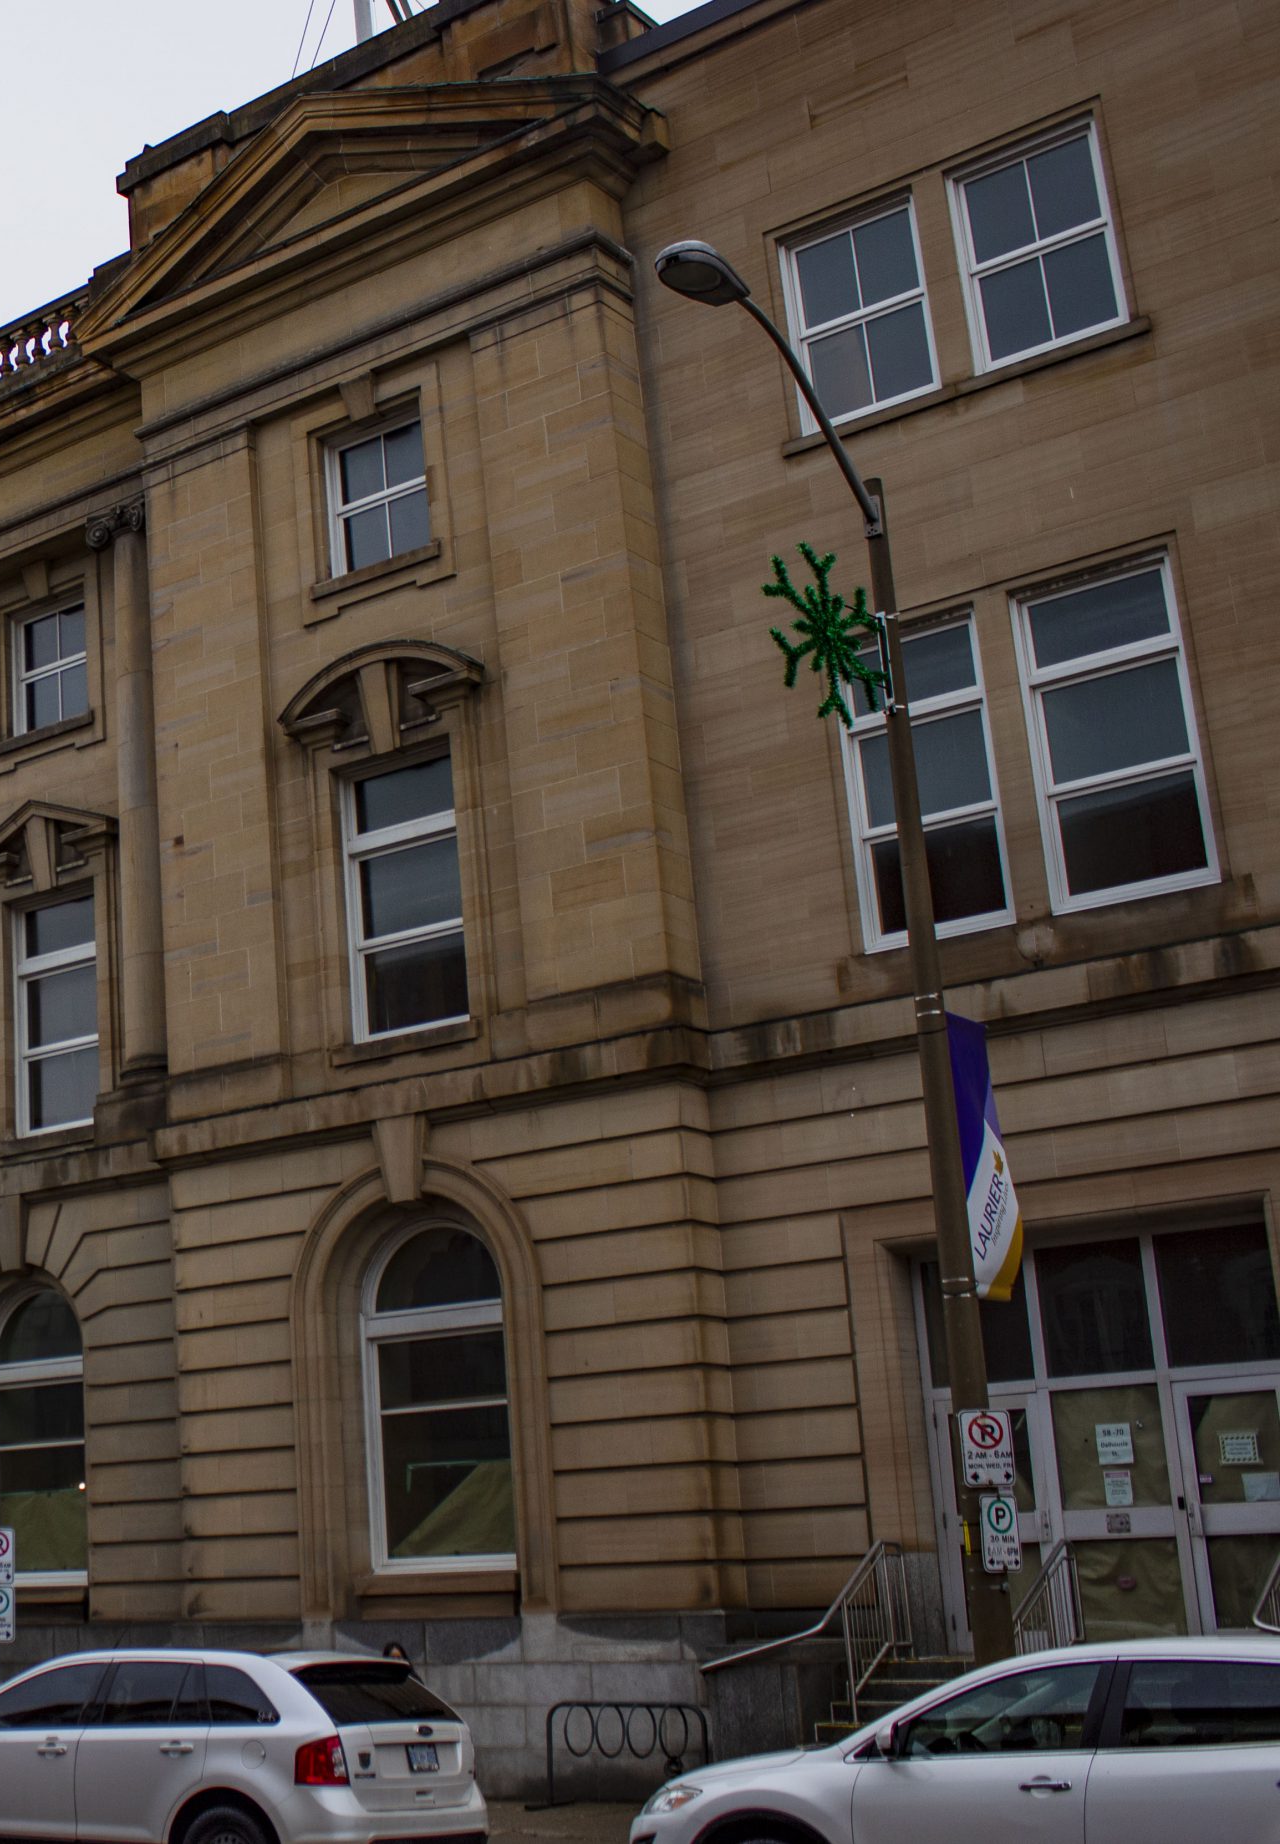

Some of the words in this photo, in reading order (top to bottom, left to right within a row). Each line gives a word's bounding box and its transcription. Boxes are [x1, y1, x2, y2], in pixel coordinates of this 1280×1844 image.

[974, 1173, 1004, 1262] LAURIER
[994, 1507, 1006, 1525] P
[1001, 1535, 1015, 1543] MIN
